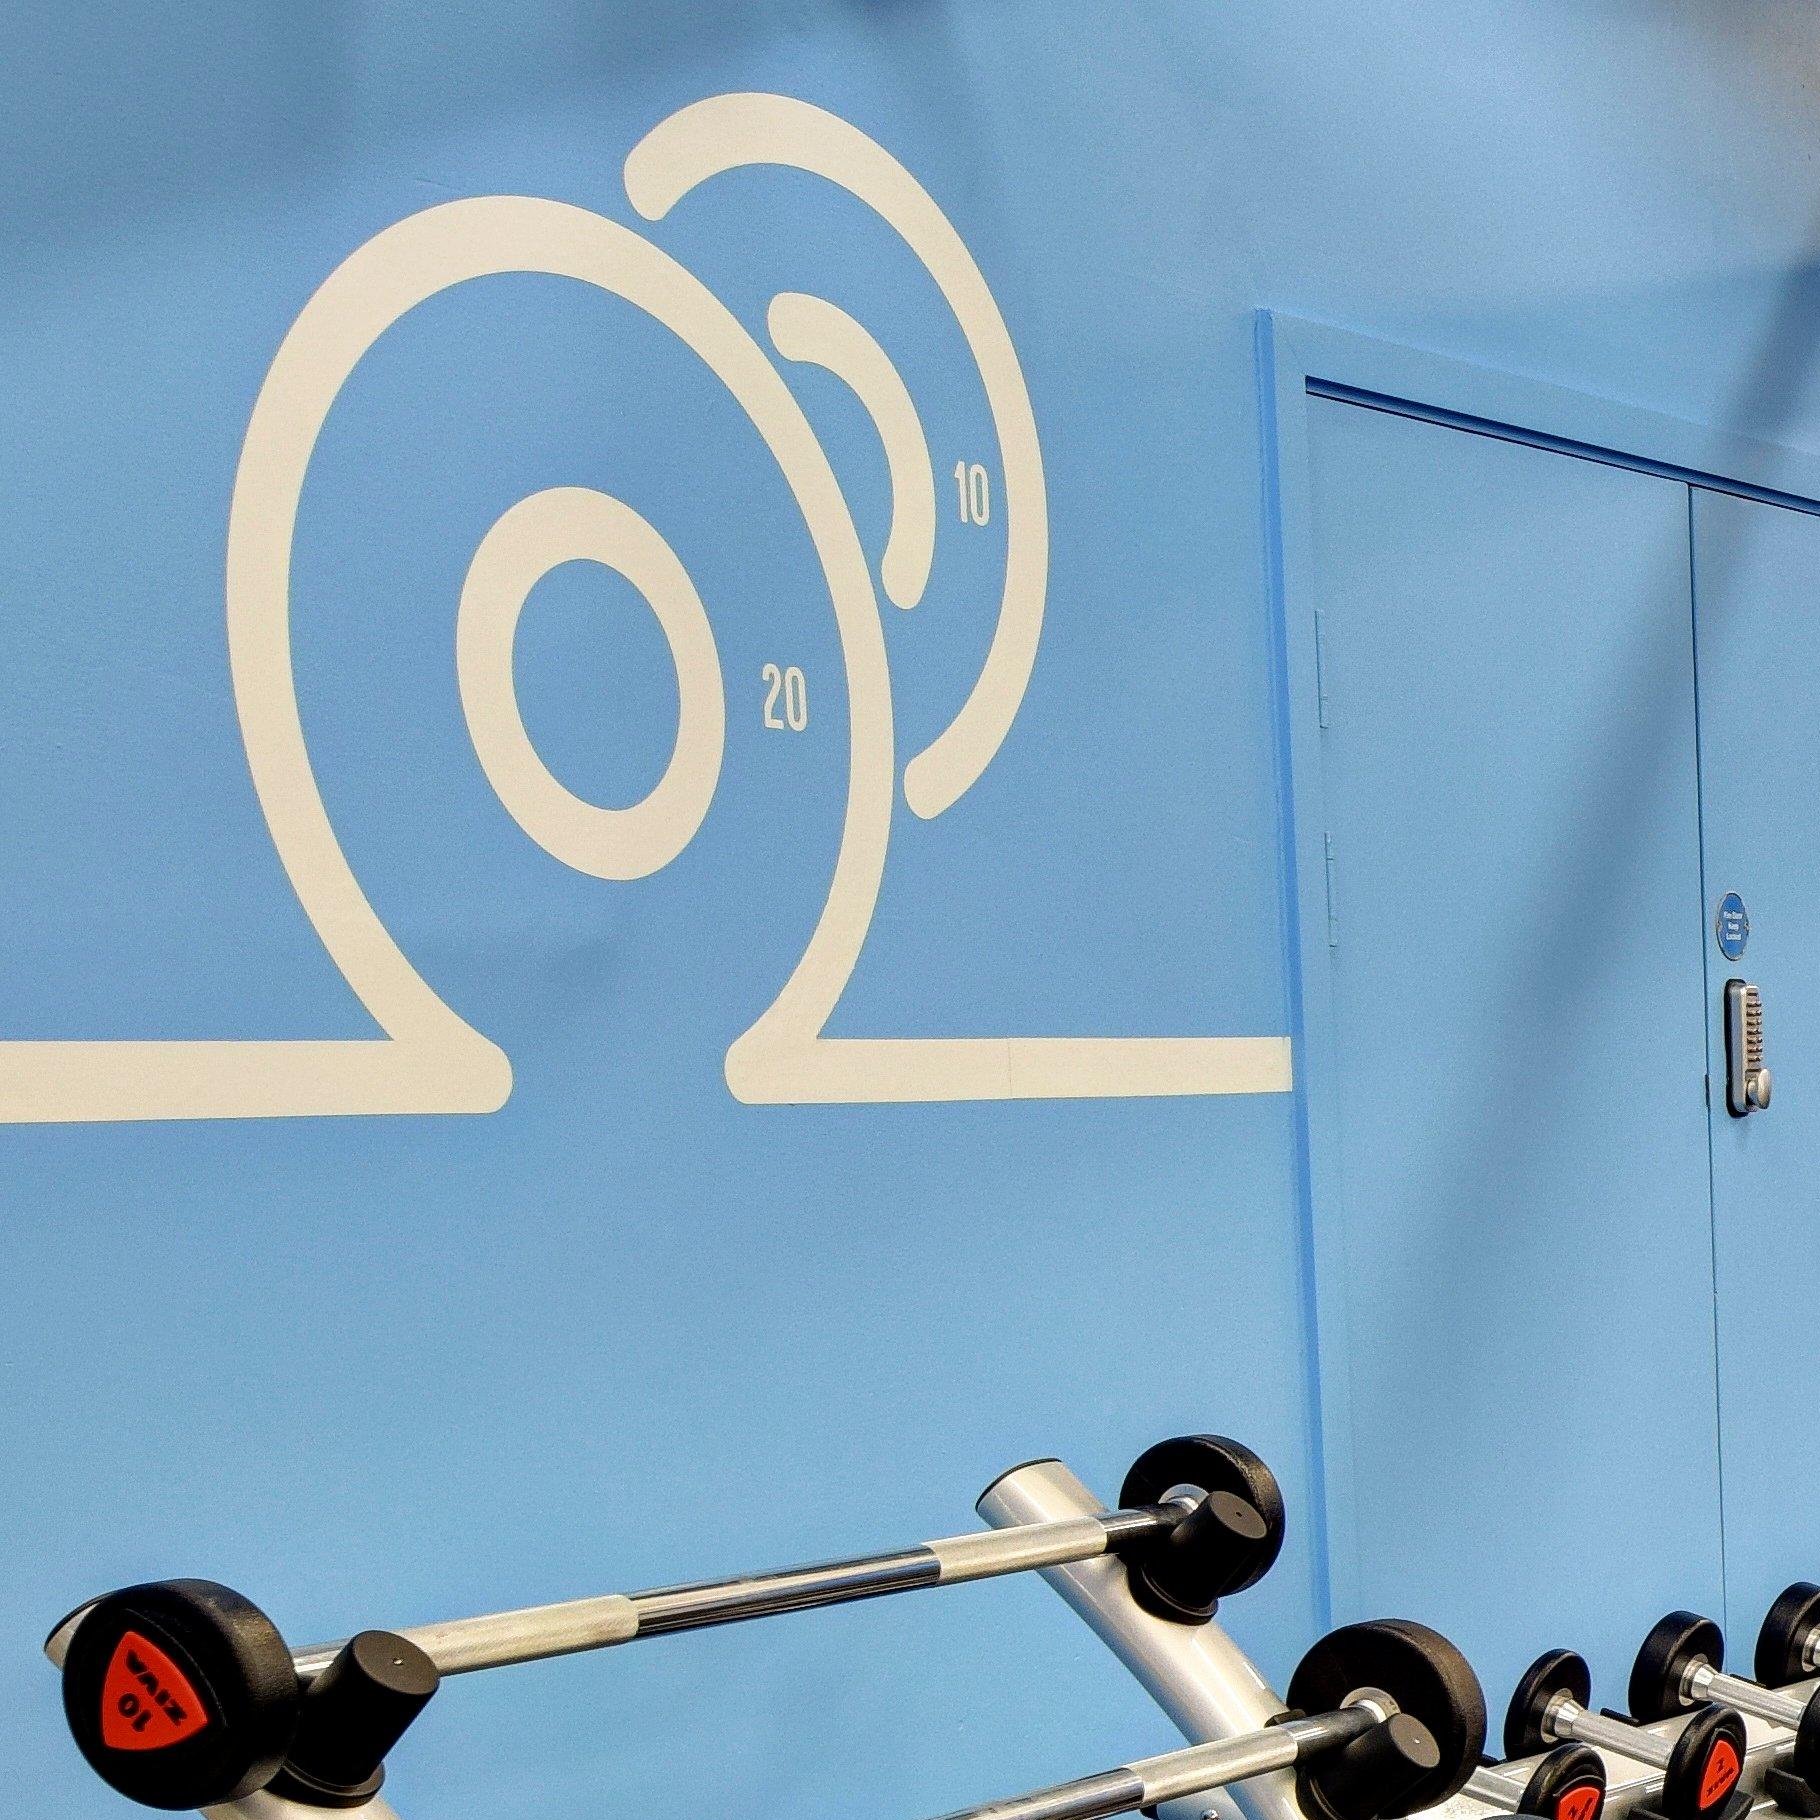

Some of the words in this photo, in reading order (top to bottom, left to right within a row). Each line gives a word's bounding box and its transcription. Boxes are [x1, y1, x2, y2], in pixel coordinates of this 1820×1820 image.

[954, 460, 990, 527] 10
[762, 663, 807, 732] 20
[117, 1692, 153, 1734] 10
[125, 1648, 188, 1727] ZIVA
